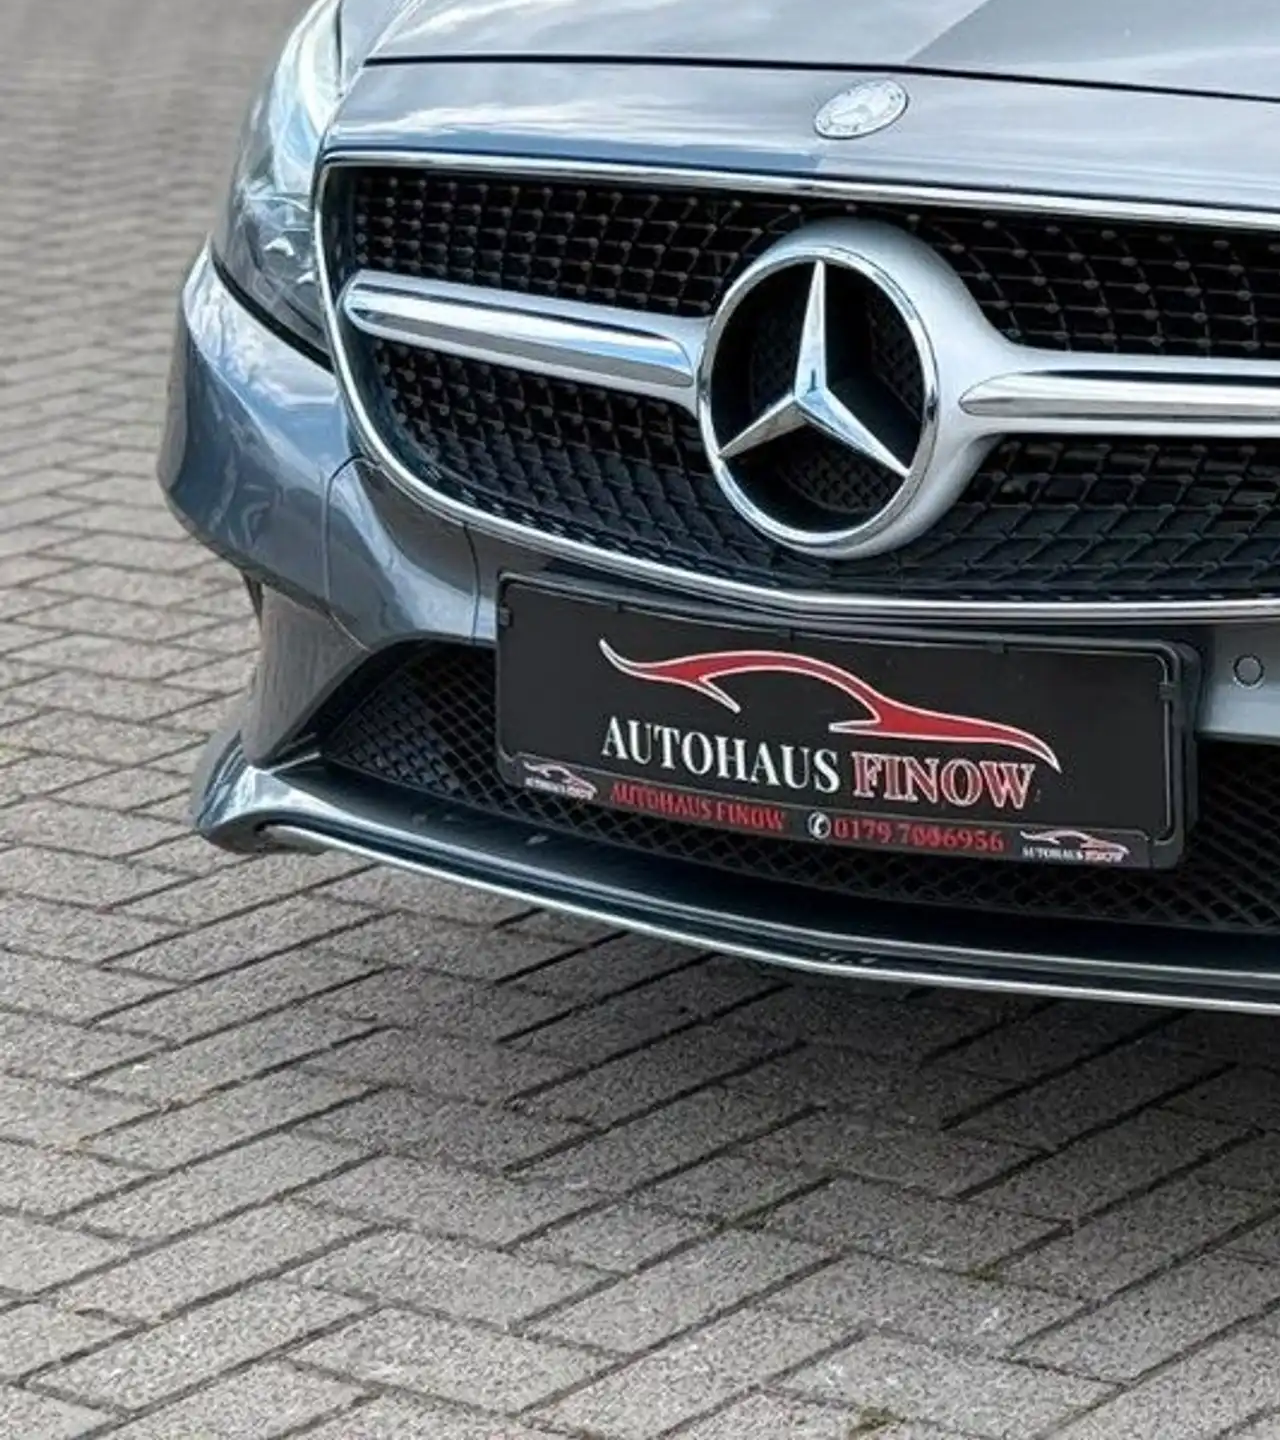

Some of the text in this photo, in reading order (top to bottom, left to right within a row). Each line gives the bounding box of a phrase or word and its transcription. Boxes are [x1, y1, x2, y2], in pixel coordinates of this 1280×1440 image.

[600, 715, 1036, 810] AUTOHAUS FINOW
[610, 780, 714, 821] AUTOHAUS
[715, 795, 785, 831] FINOW
